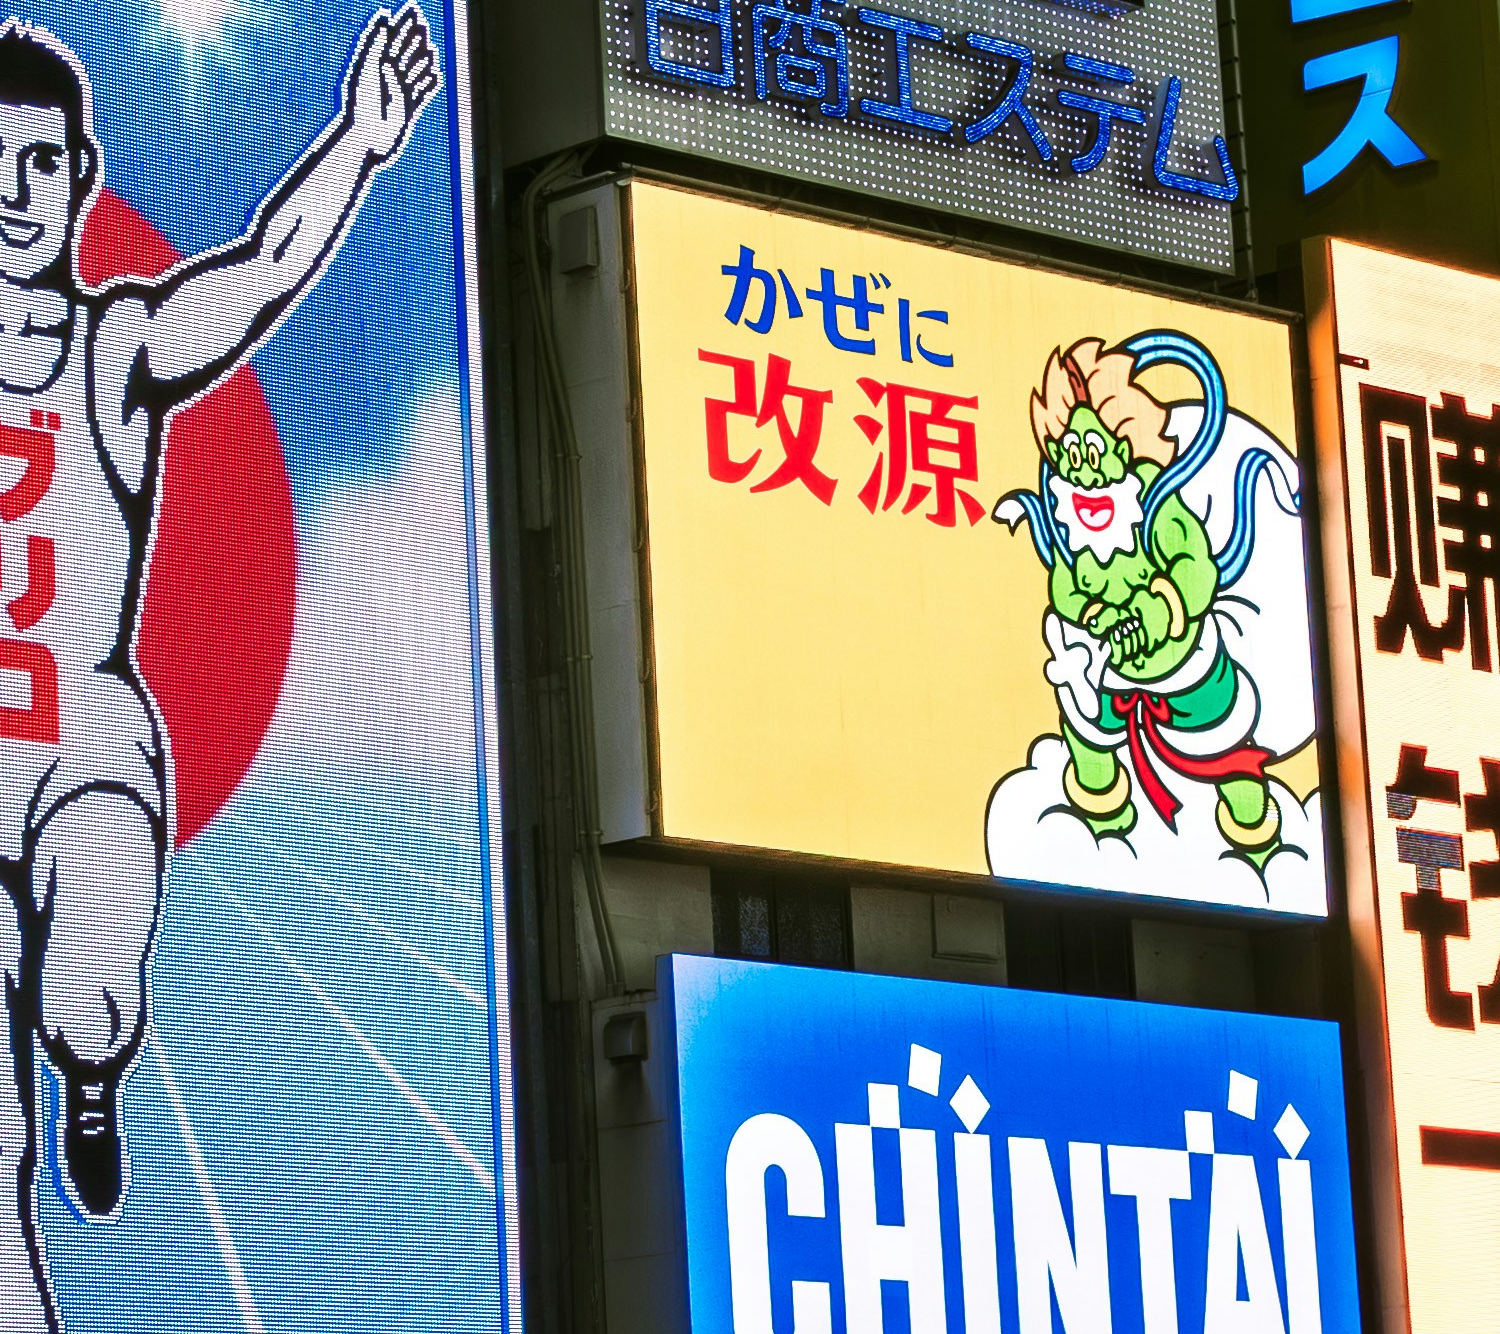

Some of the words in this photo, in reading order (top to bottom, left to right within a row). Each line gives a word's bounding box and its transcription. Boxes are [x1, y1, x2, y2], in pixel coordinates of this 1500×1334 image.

[719, 242, 956, 370] かぜに
[696, 345, 989, 529] 改源
